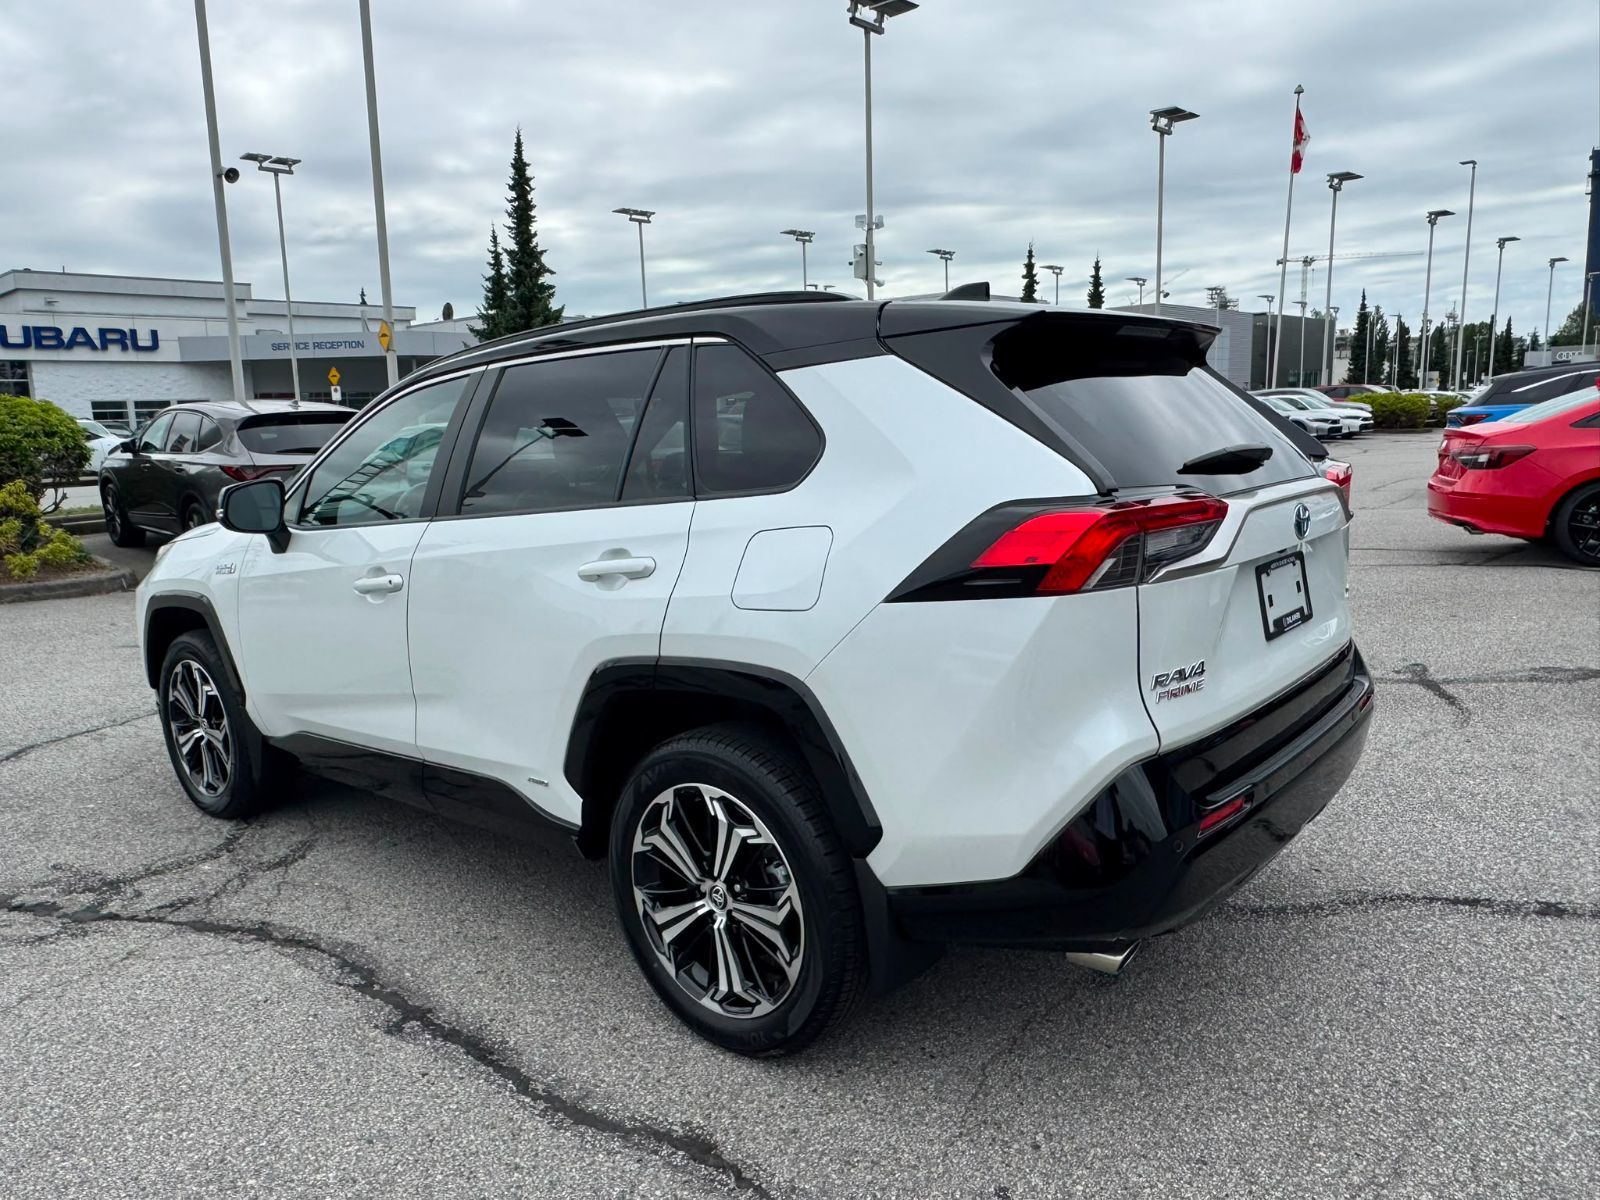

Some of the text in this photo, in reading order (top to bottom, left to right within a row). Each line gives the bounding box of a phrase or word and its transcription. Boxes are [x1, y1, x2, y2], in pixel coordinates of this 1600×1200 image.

[313, 340, 365, 350] RECEPTION
[1151, 659, 1206, 691] RAV4
[1156, 677, 1205, 704] PRIME
